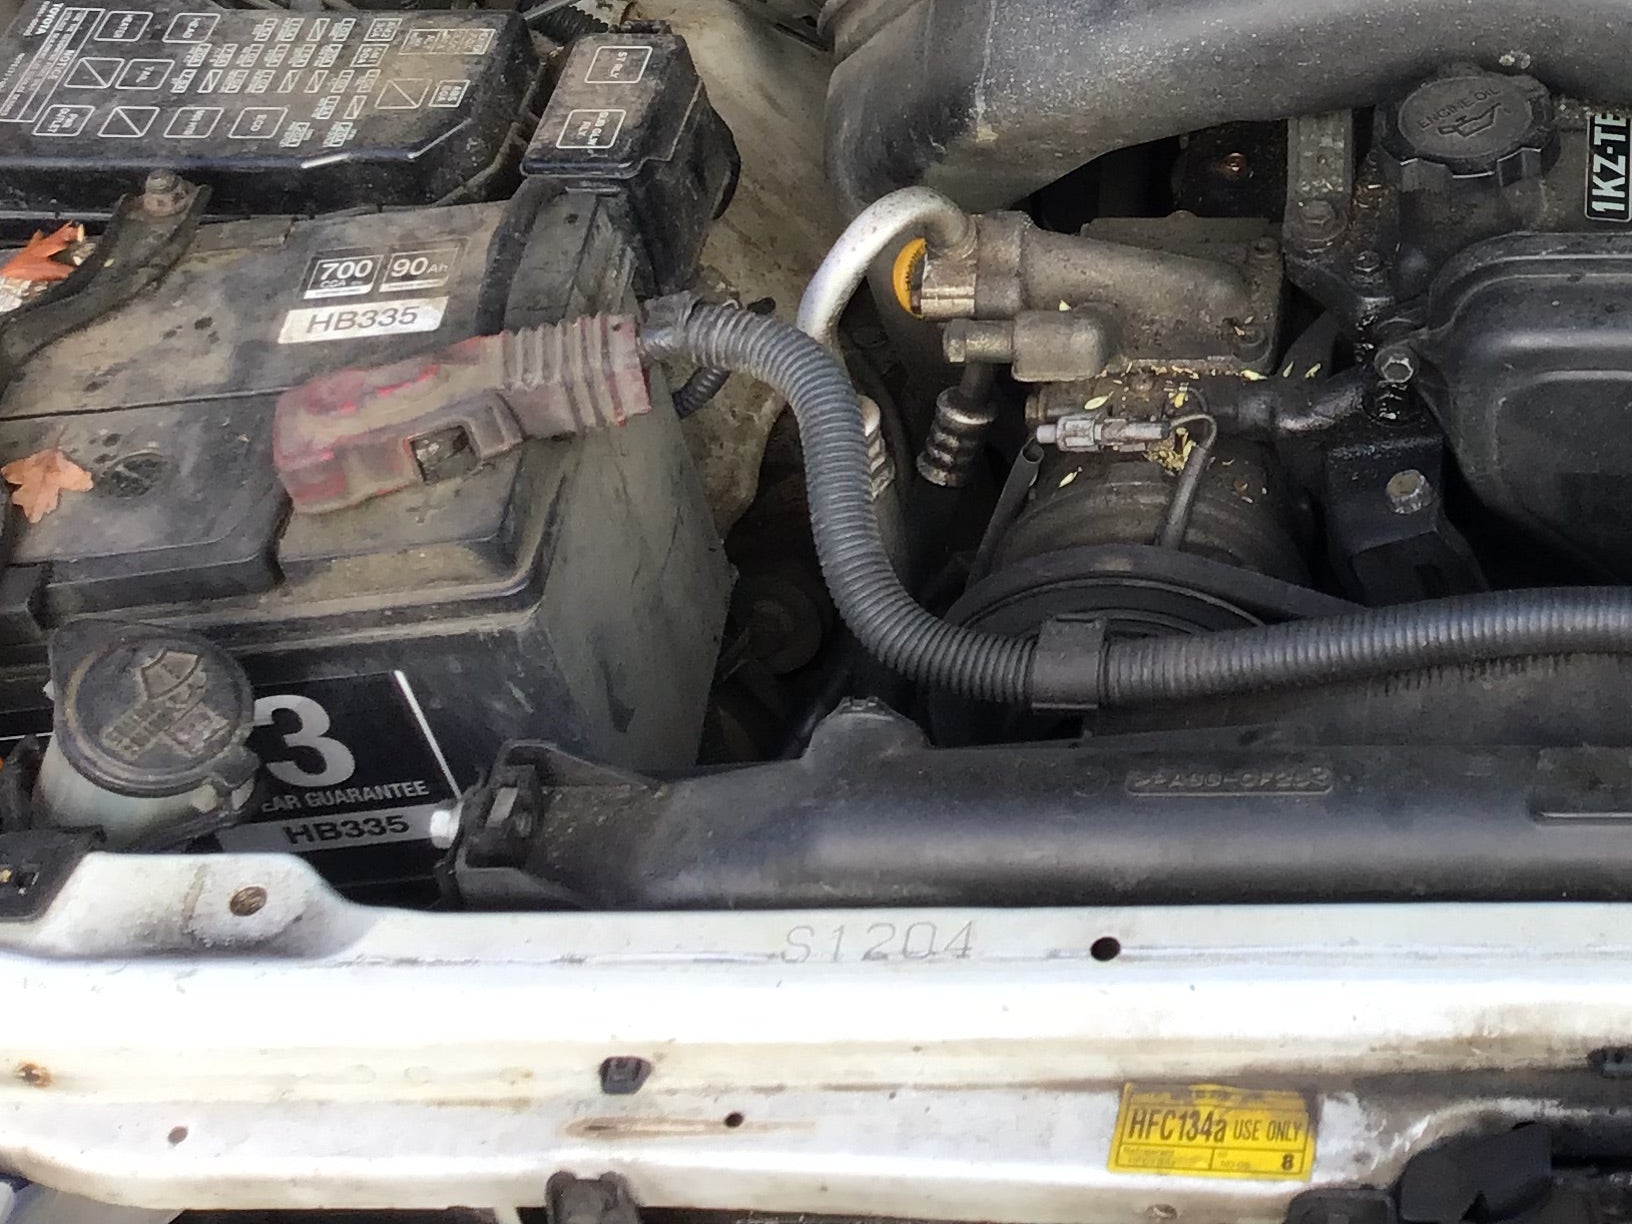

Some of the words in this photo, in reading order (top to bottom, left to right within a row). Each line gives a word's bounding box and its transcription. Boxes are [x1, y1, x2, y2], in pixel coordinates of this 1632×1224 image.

[34, 2, 64, 36] TOYOTA
[113, 14, 135, 38] HEATER
[182, 17, 202, 39] HEAD
[48, 49, 76, 80] NOTICE
[616, 51, 628, 62] ST
[136, 65, 156, 83] TAIL
[1417, 96, 1472, 130] ENGINE
[1473, 86, 1500, 102] OIL
[320, 259, 374, 281] 700
[306, 306, 420, 334] HB335
[252, 693, 356, 787] 3
[305, 780, 430, 808] GUARANTEE
[283, 814, 410, 844] HB335
[780, 920, 974, 963] S1204
[1128, 1108, 1227, 1143] HFC134a
[1233, 1119, 1262, 1140] USE
[1266, 1119, 1302, 1142] ONLY
[1280, 1153, 1294, 1171] 8
